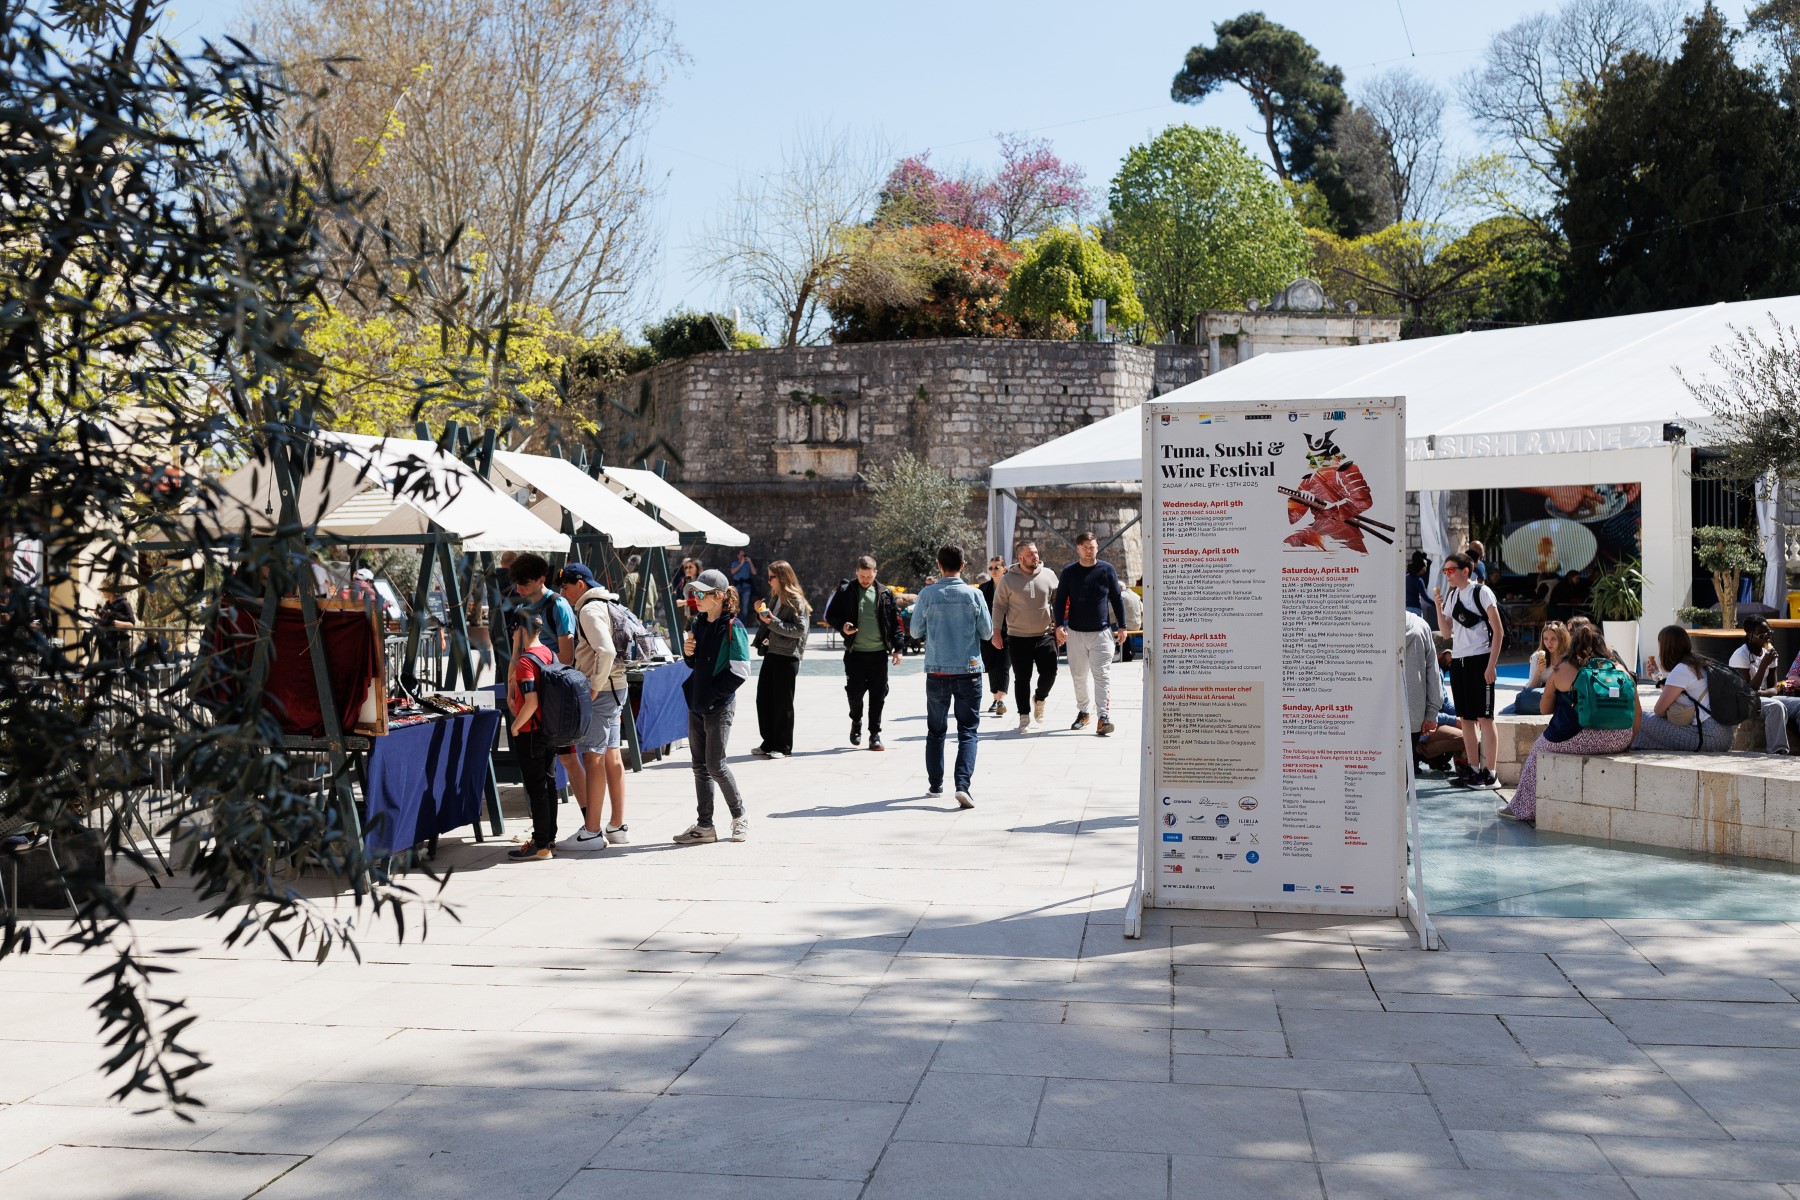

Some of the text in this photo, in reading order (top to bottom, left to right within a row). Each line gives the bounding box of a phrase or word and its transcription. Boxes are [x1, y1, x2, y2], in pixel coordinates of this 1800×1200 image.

[1161, 442, 1285, 460] Tuna, Sushi &
[1439, 434, 1516, 458] SUSHI
[1528, 432, 1543, 454] &
[1548, 428, 1621, 453] WINE
[1161, 462, 1275, 479] Wine Festival
[1210, 500, 1229, 508] April
